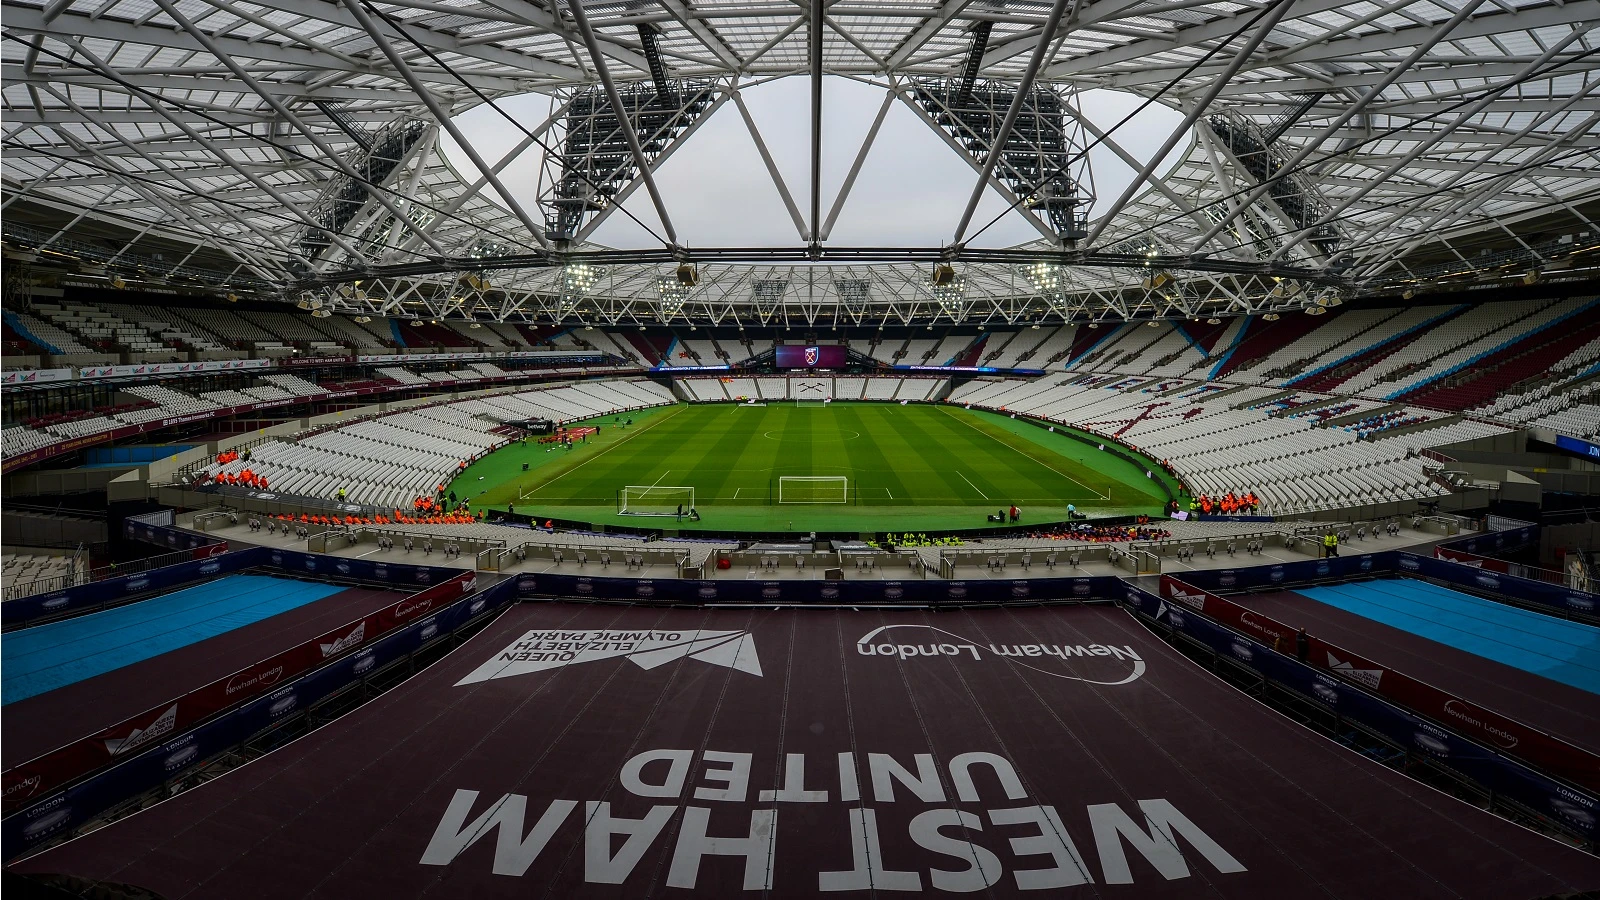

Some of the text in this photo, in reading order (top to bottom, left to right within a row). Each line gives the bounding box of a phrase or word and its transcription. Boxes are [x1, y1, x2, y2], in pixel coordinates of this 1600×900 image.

[1241, 616, 1263, 631] Newham
[530, 632, 682, 641] OLYMPIC PARK
[512, 641, 636, 652] ELIZABETH
[857, 643, 1143, 661] Newham London
[498, 652, 576, 663] QUEEN
[226, 666, 283, 695] Newham London
[1315, 674, 1337, 687] LONDON
[270, 686, 294, 700] LONDON
[142, 720, 174, 737] ELIZABETH
[155, 714, 175, 726] QUEEN
[1443, 704, 1519, 742] Newham London
[1418, 723, 1448, 739] LONDON
[165, 734, 194, 752] LONDON
[619, 749, 1029, 803] UNITED
[1556, 787, 1594, 808] LONDON
[26, 796, 66, 818] LONDON
[417, 788, 1249, 893] WEST HAM
